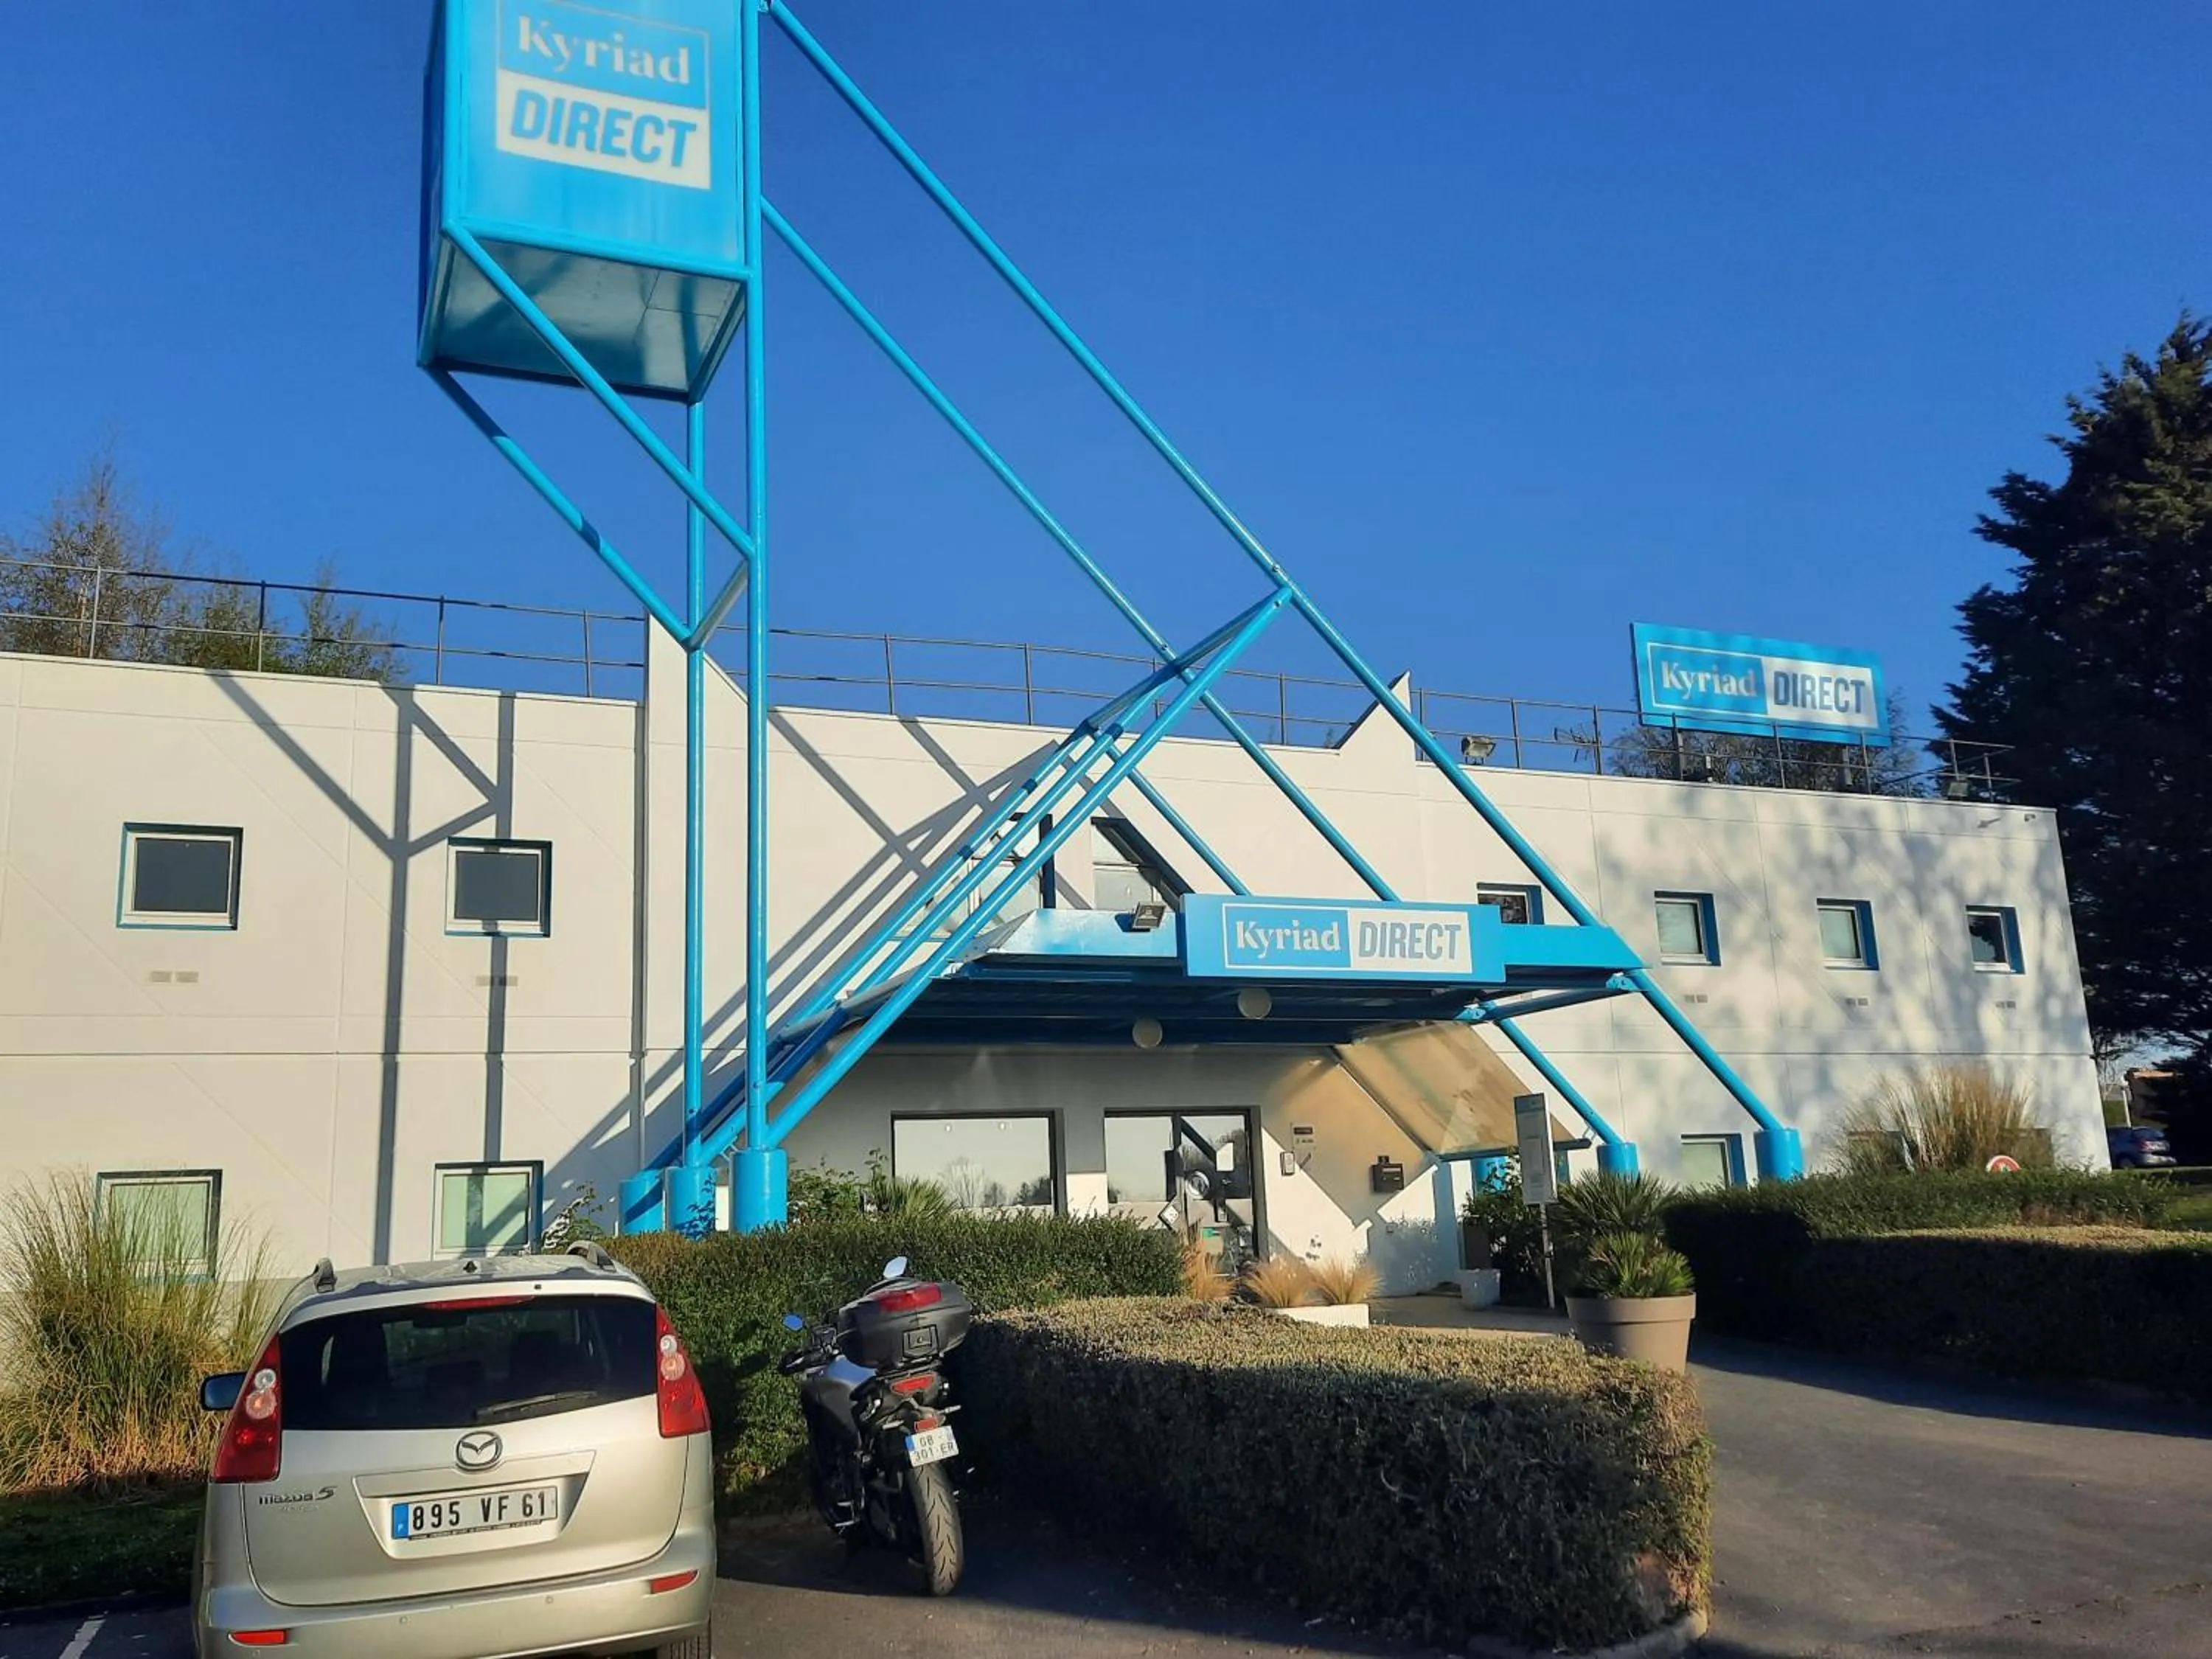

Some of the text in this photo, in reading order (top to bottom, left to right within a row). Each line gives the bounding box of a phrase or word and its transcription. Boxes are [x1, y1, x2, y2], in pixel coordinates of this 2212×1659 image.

[519, 15, 689, 83] Kyriad
[510, 89, 697, 167] DIRECT
[1662, 661, 1865, 714] Kyriad DIRECT
[1236, 920, 1461, 959] Kyriad DIRECT
[412, 1501, 460, 1531] 895
[481, 1495, 509, 1522] VF
[522, 1492, 545, 1517] 61
